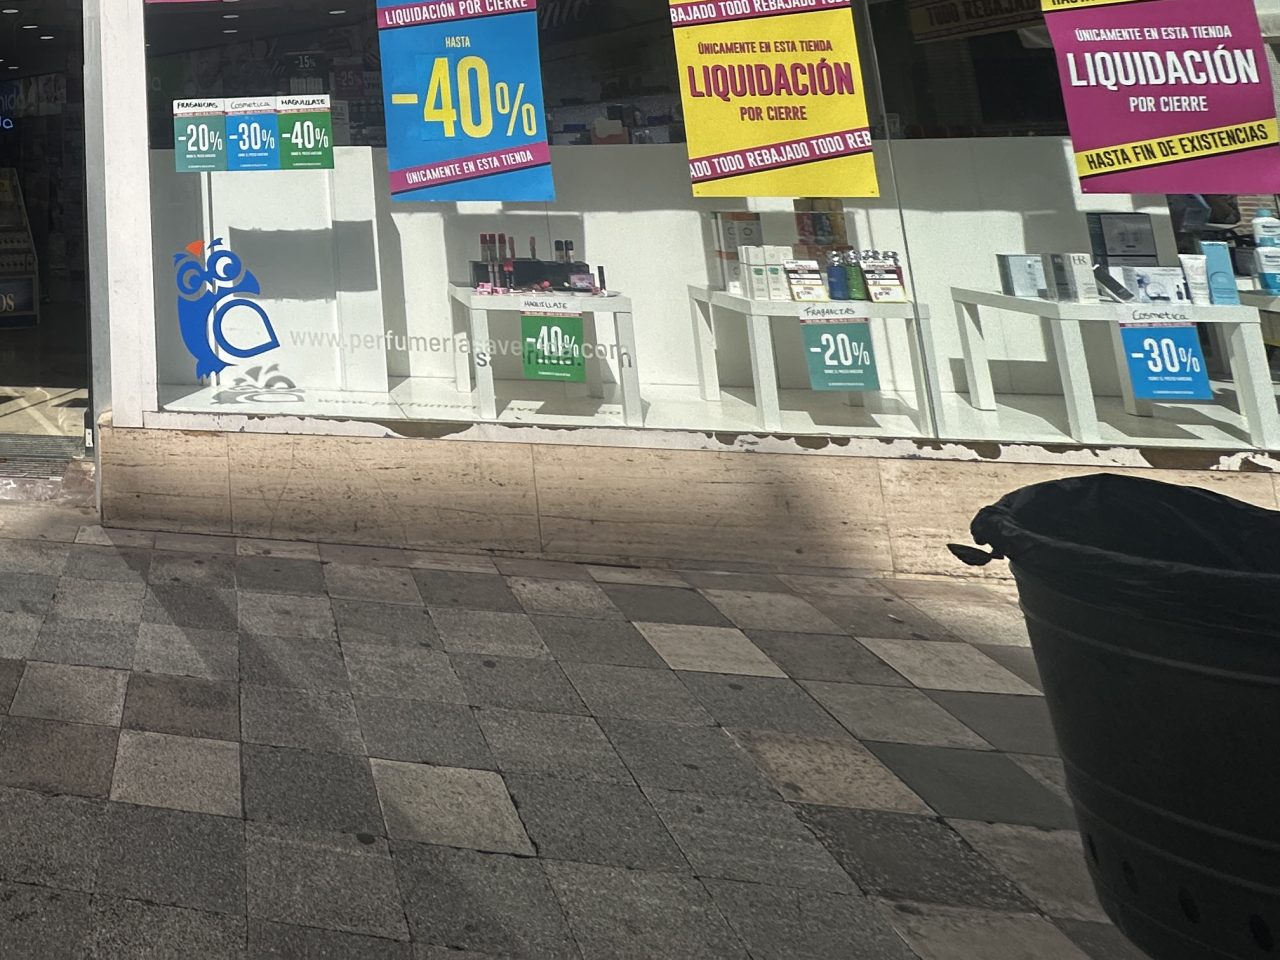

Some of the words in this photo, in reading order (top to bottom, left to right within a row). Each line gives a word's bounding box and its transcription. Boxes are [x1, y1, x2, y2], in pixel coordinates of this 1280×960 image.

[385, 3, 455, 25] LIQUIDACIÓN
[459, 0, 483, 16] POR
[670, 4, 716, 22] BAJADO
[718, 0, 750, 15] TODO
[445, 36, 471, 48] HASTA
[698, 42, 757, 54] ÚNICAMENTE
[760, 42, 771, 52] EN
[774, 40, 797, 52] ESTA
[799, 40, 833, 52] TIENDA
[1074, 27, 1142, 42] ÚNICAMENTE
[1144, 27, 1159, 40] EN
[1162, 26, 1189, 39] ESTA
[1189, 25, 1232, 39] TIENDA
[687, 58, 855, 101] LIQUIDACIÓN
[1066, 44, 1260, 91] LIQUIDACIÓN
[392, 55, 537, 138] -40%
[1129, 97, 1156, 112] POR
[1160, 96, 1209, 112] CIERRE
[740, 106, 763, 121] POR
[766, 106, 807, 121] CIERRE
[178, 124, 222, 152] -20%
[229, 123, 275, 151] -30%
[282, 121, 328, 149] -40%
[1085, 151, 1132, 170] HASTA
[1135, 144, 1157, 163] FIN
[1160, 140, 1176, 159] DE
[1180, 124, 1269, 154] EXISTENCIAS
[406, 165, 461, 184] ÚNICAMENTE
[463, 162, 475, 176] EN
[477, 158, 500, 173] ESTA
[502, 152, 533, 169] TIENDA
[690, 161, 712, 178] ADO
[714, 154, 745, 173] TODO
[746, 142, 810, 167] REBAJADO
[811, 136, 844, 155] TODO
[846, 131, 872, 148] REB
[1133, 310, 1189, 321] Cosmetica
[810, 333, 871, 366] -20%
[1131, 338, 1201, 373] -30%
